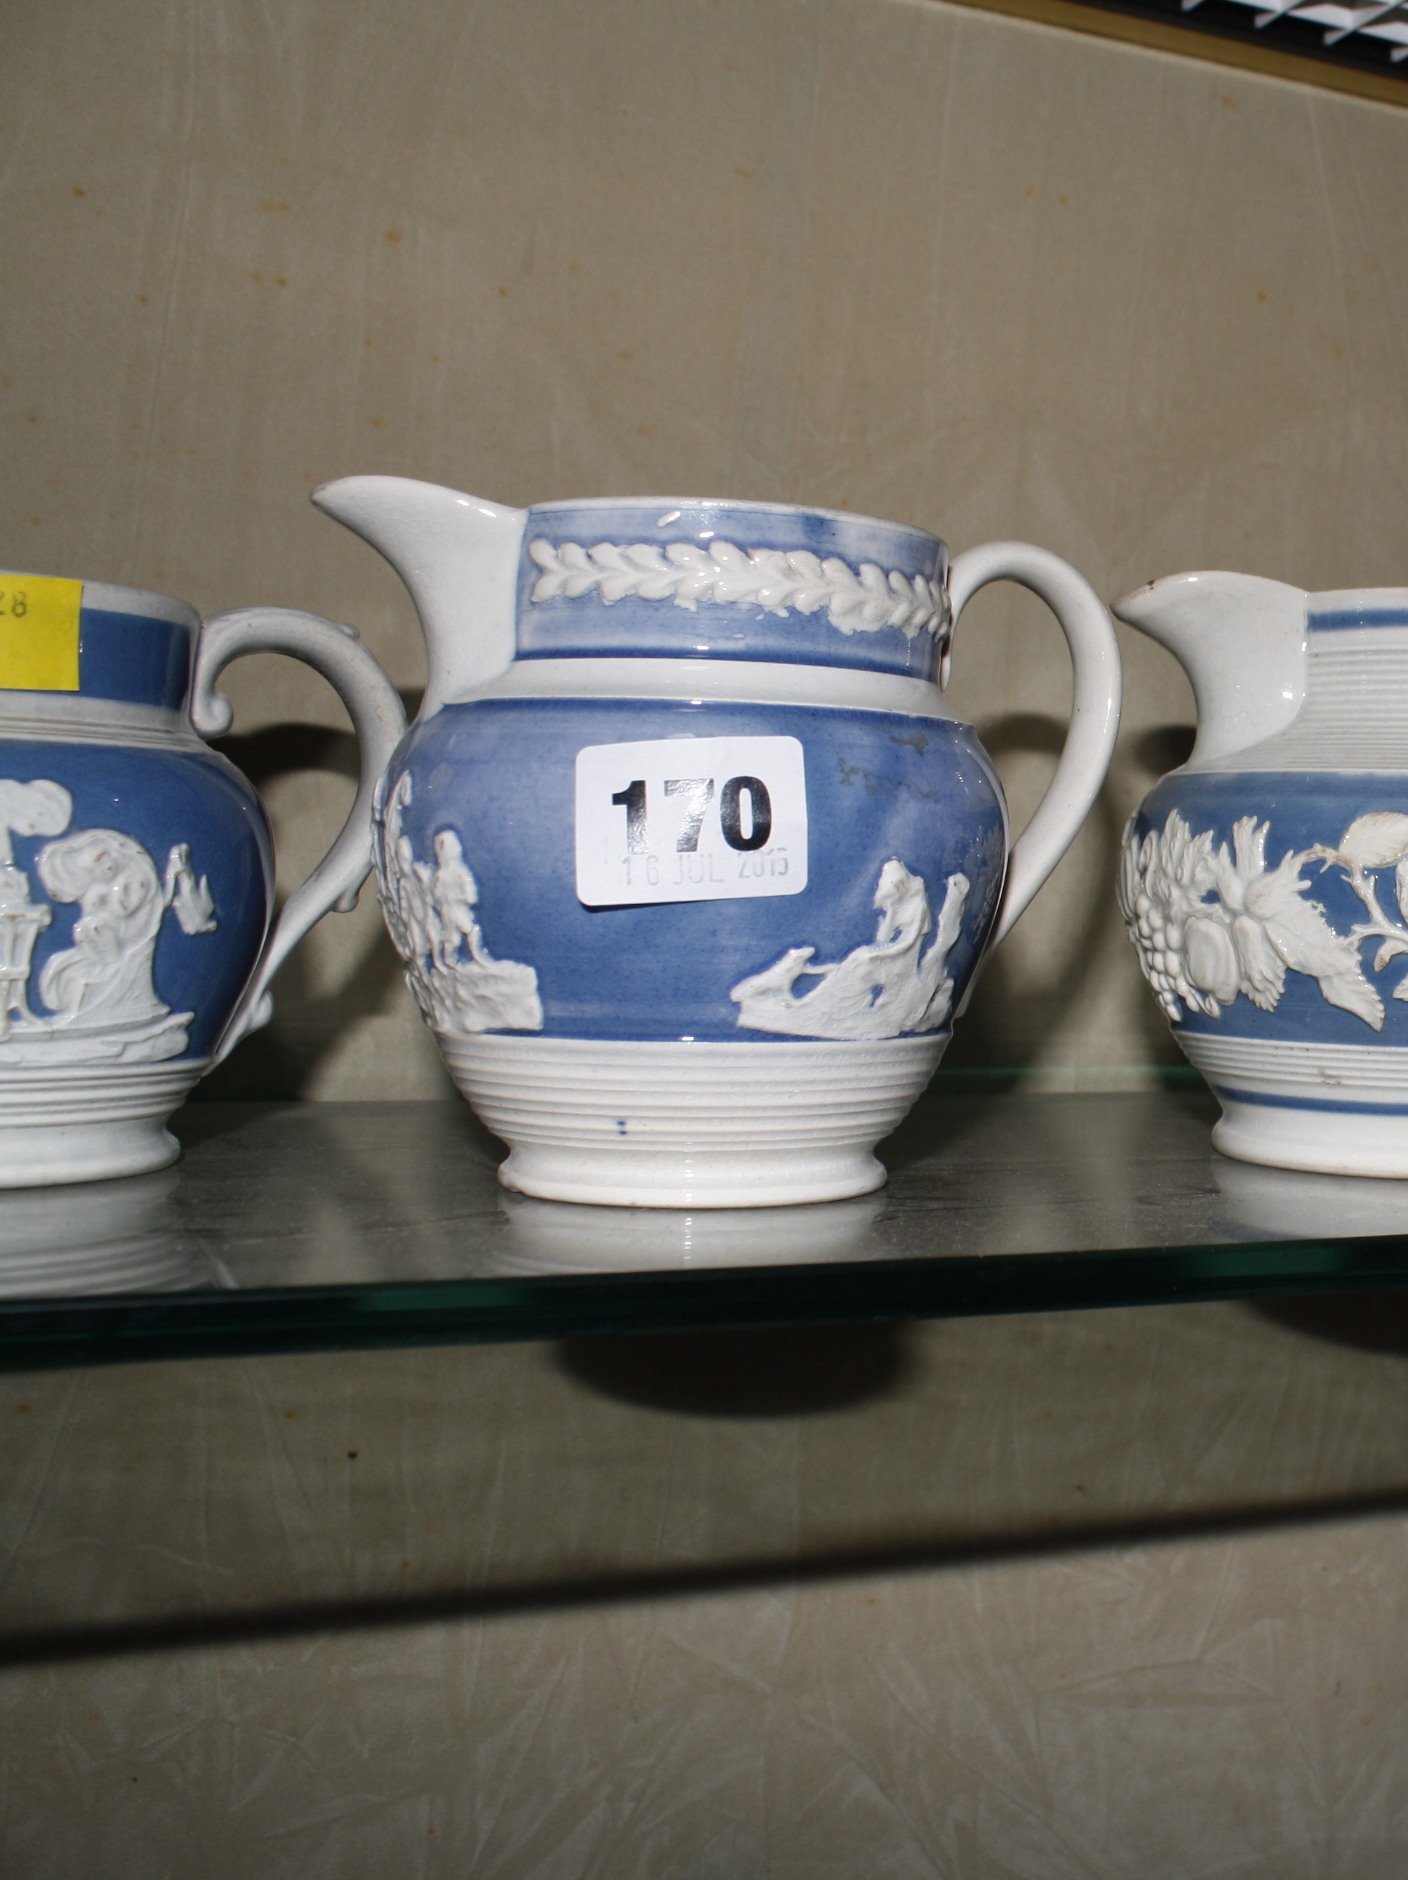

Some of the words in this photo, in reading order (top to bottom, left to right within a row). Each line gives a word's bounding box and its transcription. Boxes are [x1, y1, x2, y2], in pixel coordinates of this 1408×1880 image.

[611, 775, 772, 855] 170
[621, 853, 660, 887] 16
[672, 853, 725, 886] JUL
